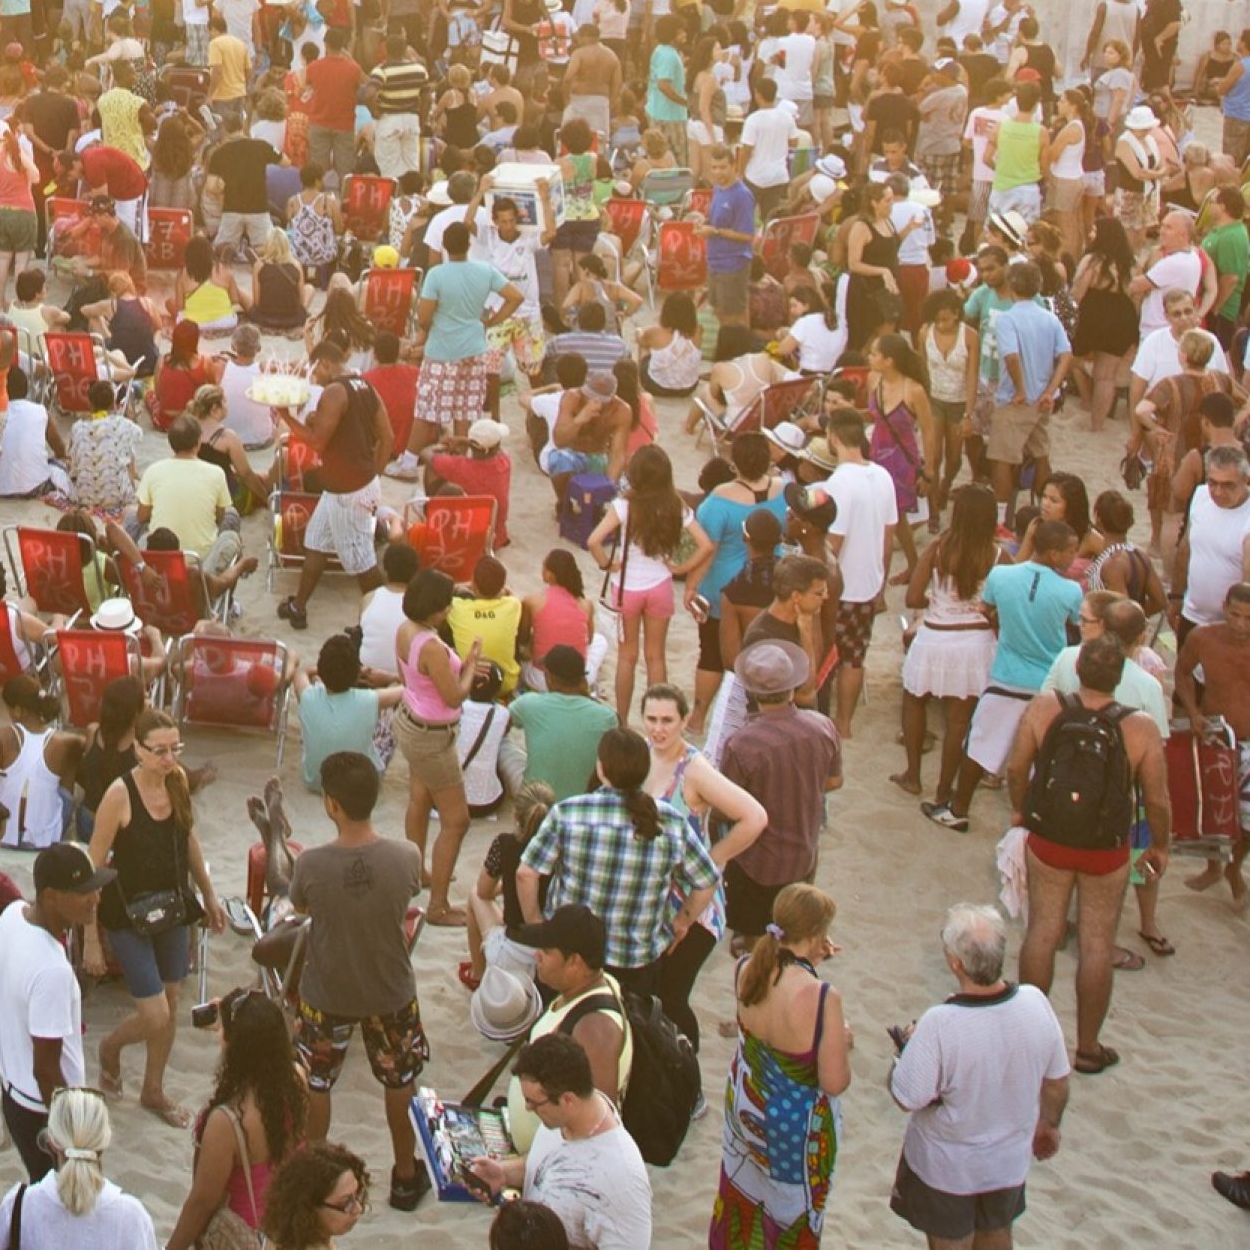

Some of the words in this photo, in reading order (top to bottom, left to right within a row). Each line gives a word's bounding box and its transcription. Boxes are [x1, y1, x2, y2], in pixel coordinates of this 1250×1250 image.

[371, 276, 402, 306] PH
[49, 338, 86, 372] PH
[429, 508, 474, 552] PH
[63, 644, 106, 679] PH
